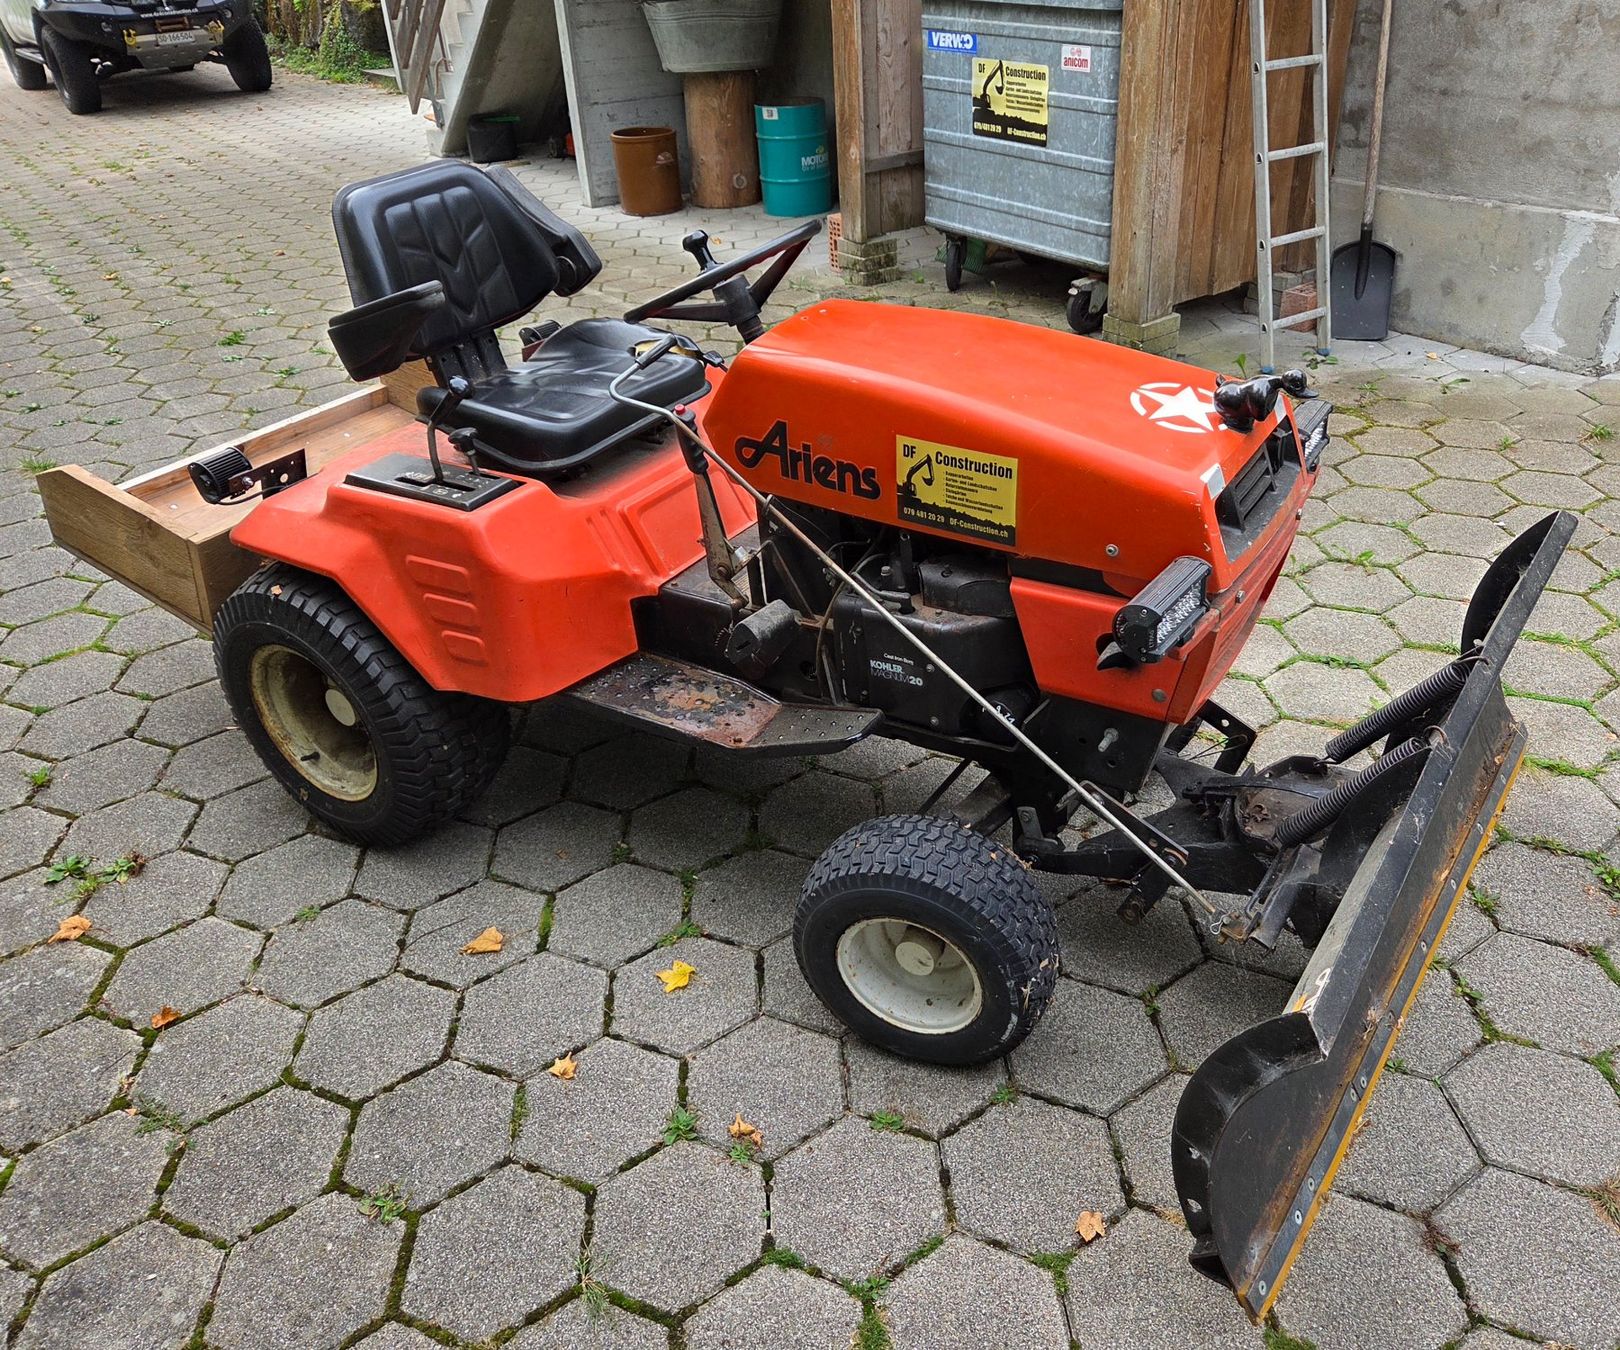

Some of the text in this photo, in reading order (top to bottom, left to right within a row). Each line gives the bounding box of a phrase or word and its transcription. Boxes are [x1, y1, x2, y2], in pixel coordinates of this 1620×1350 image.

[978, 63, 1046, 81] DF Construction
[734, 419, 881, 500] Ariens
[903, 444, 1013, 479] DF Construction
[903, 507, 915, 516] 079
[927, 512, 936, 521] 20
[936, 514, 945, 523] 29
[949, 517, 1009, 538] DF-Construction.ch
[870, 659, 904, 674] KOHLER
